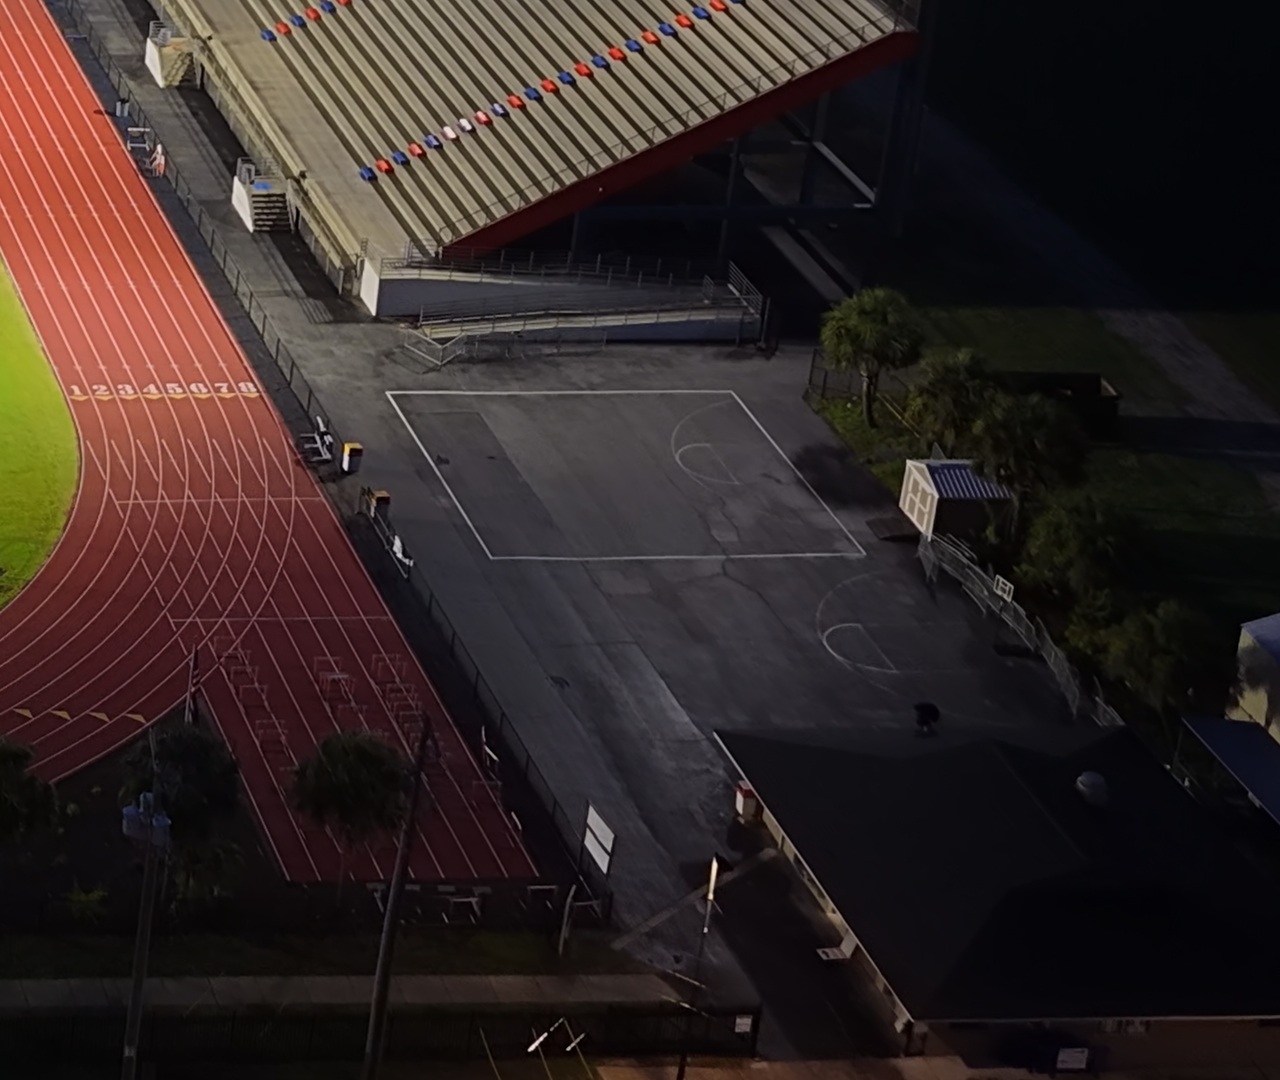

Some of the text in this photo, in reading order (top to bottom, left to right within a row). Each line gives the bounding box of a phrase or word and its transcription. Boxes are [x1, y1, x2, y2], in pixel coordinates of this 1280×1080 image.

[70, 382, 257, 395] 1 2 3 4 5 6 7 8
